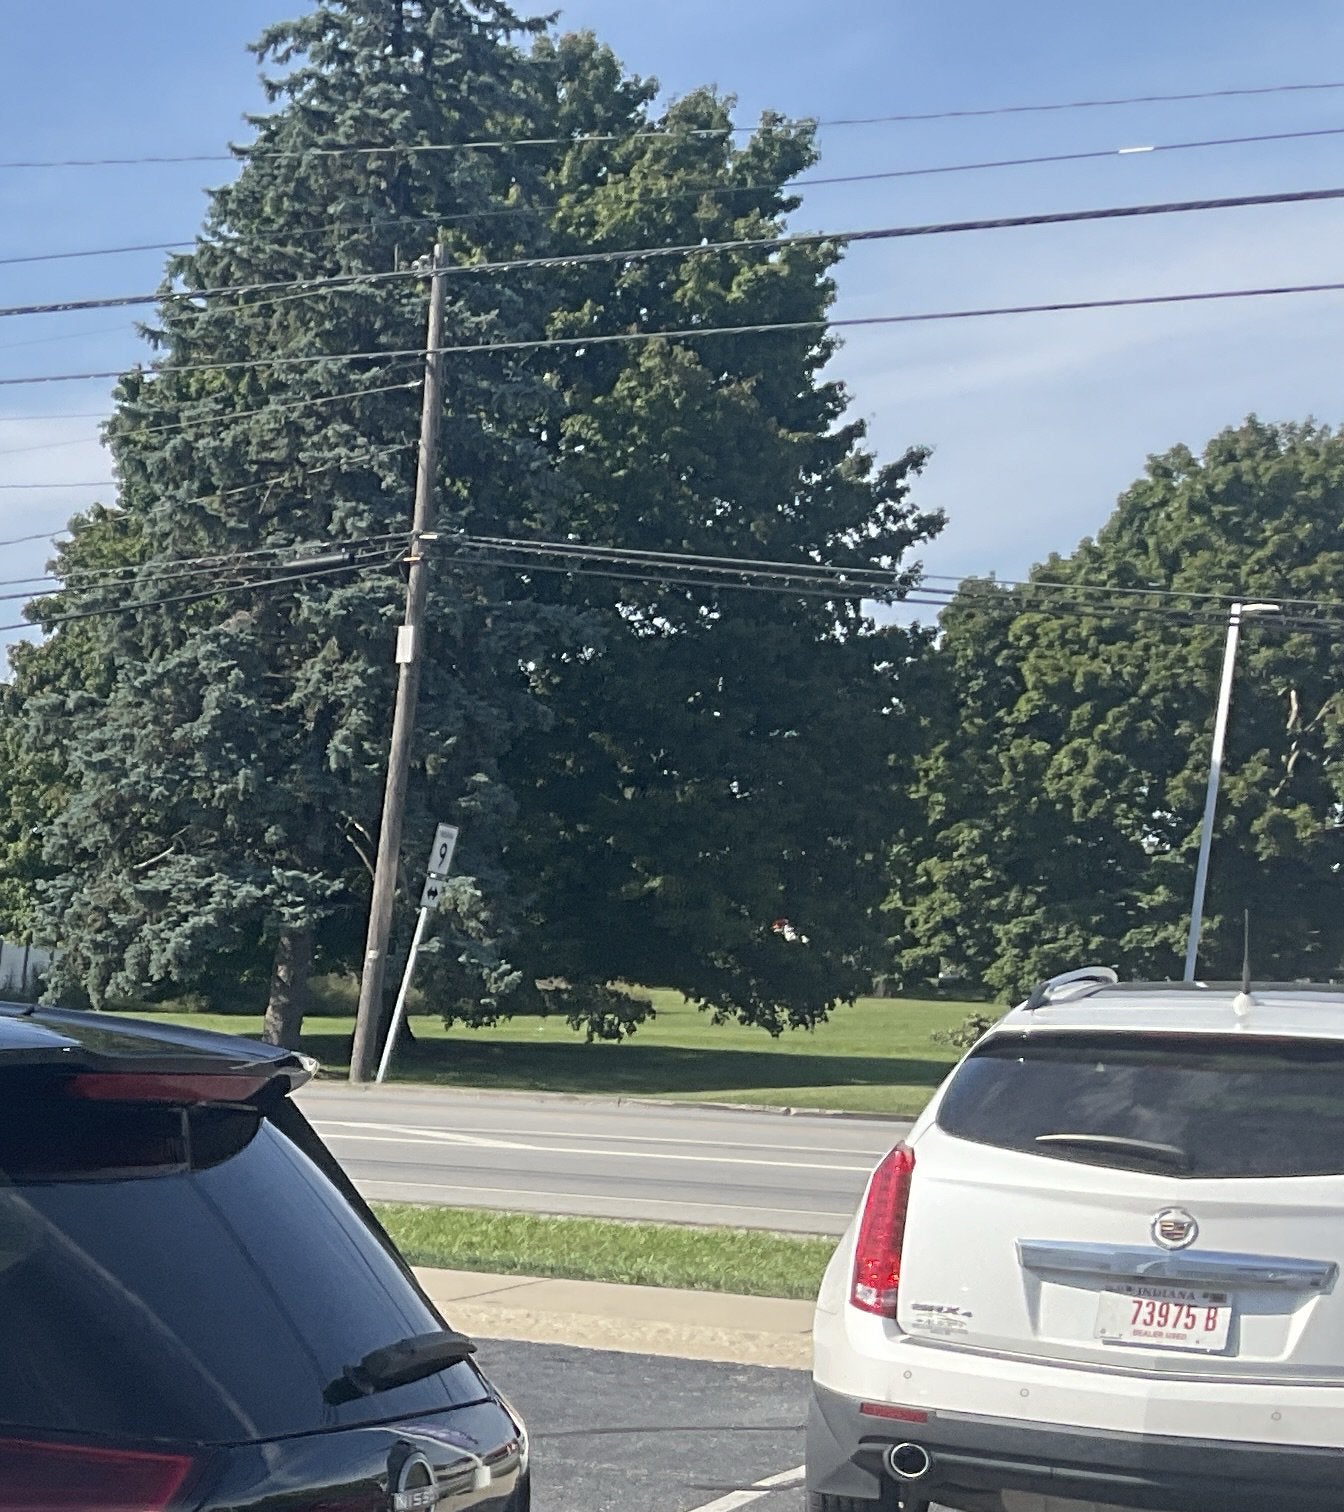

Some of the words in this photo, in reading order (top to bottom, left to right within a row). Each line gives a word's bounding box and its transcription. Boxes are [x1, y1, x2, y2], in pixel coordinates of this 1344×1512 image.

[438, 842, 448, 870] 9
[1137, 1287, 1196, 1301] INDIANA
[1131, 1300, 1197, 1330] 73975
[1204, 1306, 1218, 1332] B
[393, 1490, 439, 1511] NISS
